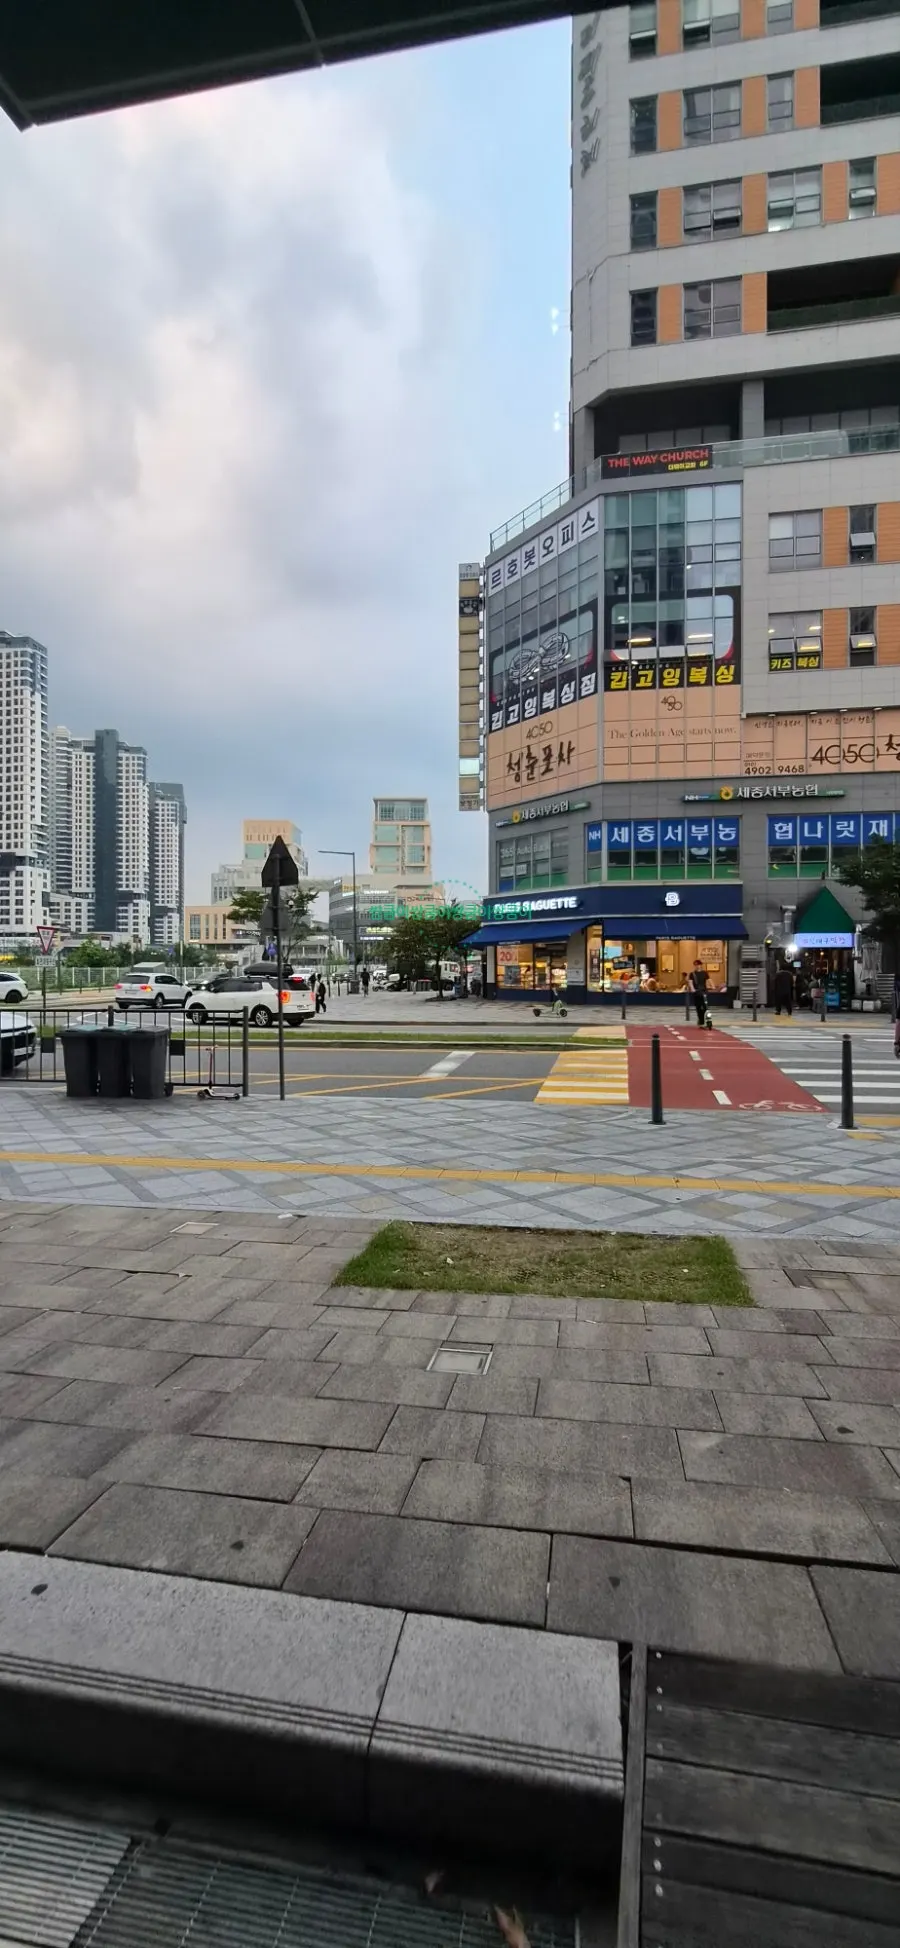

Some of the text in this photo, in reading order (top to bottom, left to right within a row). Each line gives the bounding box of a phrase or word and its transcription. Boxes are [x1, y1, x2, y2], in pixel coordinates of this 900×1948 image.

[608, 448, 709, 468] THE WAY CHURCH
[490, 511, 596, 590] 르호봇오피스
[771, 658, 792, 669] 키즈
[610, 664, 736, 690] 킵고잉복싱
[491, 672, 596, 731] 킵고잉복싱짐
[526, 720, 553, 739] 4050
[607, 730, 627, 739] The
[630, 728, 664, 738] Golden
[668, 727, 685, 737] Age
[689, 727, 711, 735] starts
[811, 743, 880, 765] 4050
[745, 764, 805, 775] 4902 9468
[736, 783, 819, 799] 세종서부농협
[521, 800, 569, 820] 세종서부농협
[588, 829, 601, 840] NH
[522, 896, 578, 912] BAGUETTE
